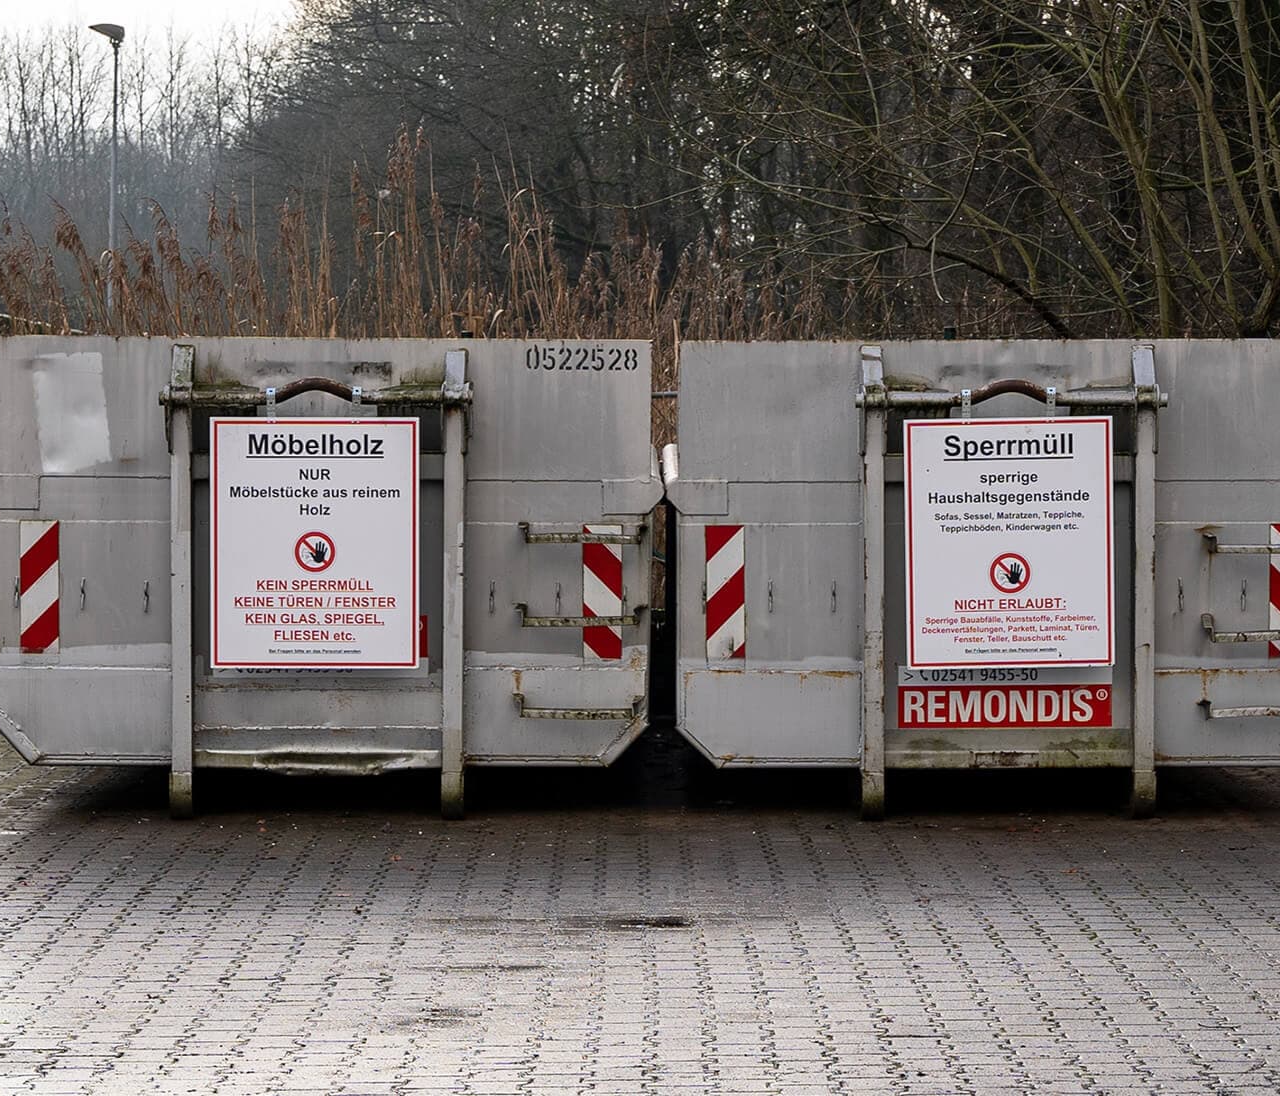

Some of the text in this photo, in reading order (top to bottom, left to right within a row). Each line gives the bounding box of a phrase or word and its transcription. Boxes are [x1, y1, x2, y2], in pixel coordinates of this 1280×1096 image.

[526, 346, 638, 371] 0522528
[247, 433, 384, 455] Möbelholz
[943, 433, 1073, 460] Sperrmüll
[298, 468, 331, 481] NUR
[979, 471, 1038, 486] sperrige
[230, 486, 401, 498] Möbelstücke aus reinem
[928, 489, 1090, 505] Haushaltsgegenstände
[299, 504, 331, 516] Holz
[934, 510, 1085, 522] Sofas, Sessel, Matratzen, Teppiche,
[941, 522, 1080, 534] Teppichböden, Kinderwagen etc.
[256, 577, 374, 591] KEIN SPERRMÜLL
[234, 596, 274, 607] KEINE
[278, 594, 325, 607] TÜREN
[334, 596, 396, 608] FENSTER
[954, 598, 1067, 610] NICHT ERLAUBT:
[245, 613, 277, 624] KEIN
[324, 613, 385, 626] SPIEGEL,
[925, 614, 1096, 625] Sperrige Bauabfälle, Kunststoffe, Farbeimer,
[1007, 625, 1038, 633] Parkett,
[1039, 624, 1072, 633] Laminat,
[1075, 623, 1100, 632] Türen,
[274, 630, 357, 641] FLIESEN etc.
[954, 635, 986, 644] Fenster,
[987, 635, 1010, 644] Teller,
[1012, 634, 1052, 643] Bauschutt
[931, 668, 1039, 682] 02541 9455-50
